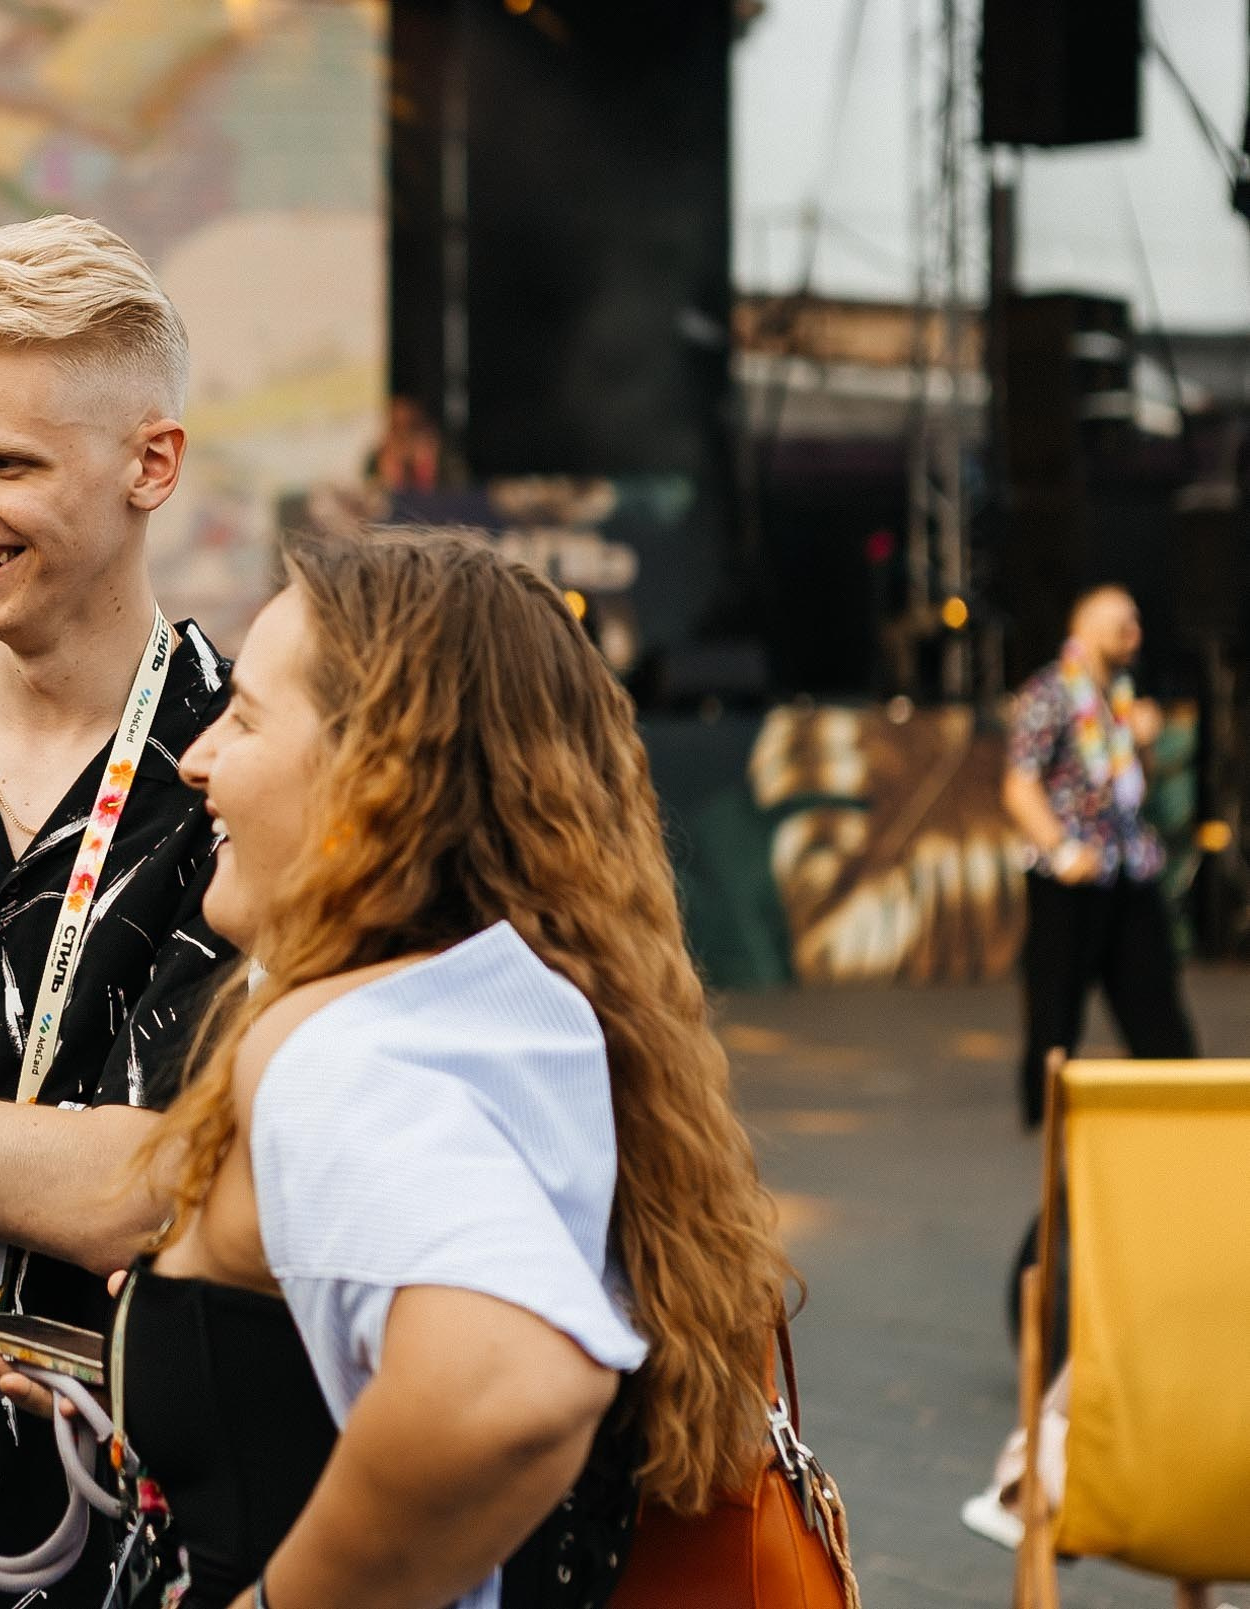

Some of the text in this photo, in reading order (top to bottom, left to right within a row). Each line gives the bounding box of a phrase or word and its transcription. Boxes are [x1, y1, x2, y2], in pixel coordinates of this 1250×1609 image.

[126, 708, 143, 743] AdsCard
[51, 925, 77, 993] СТИЛЬ
[31, 1036, 46, 1076] AdsCard
